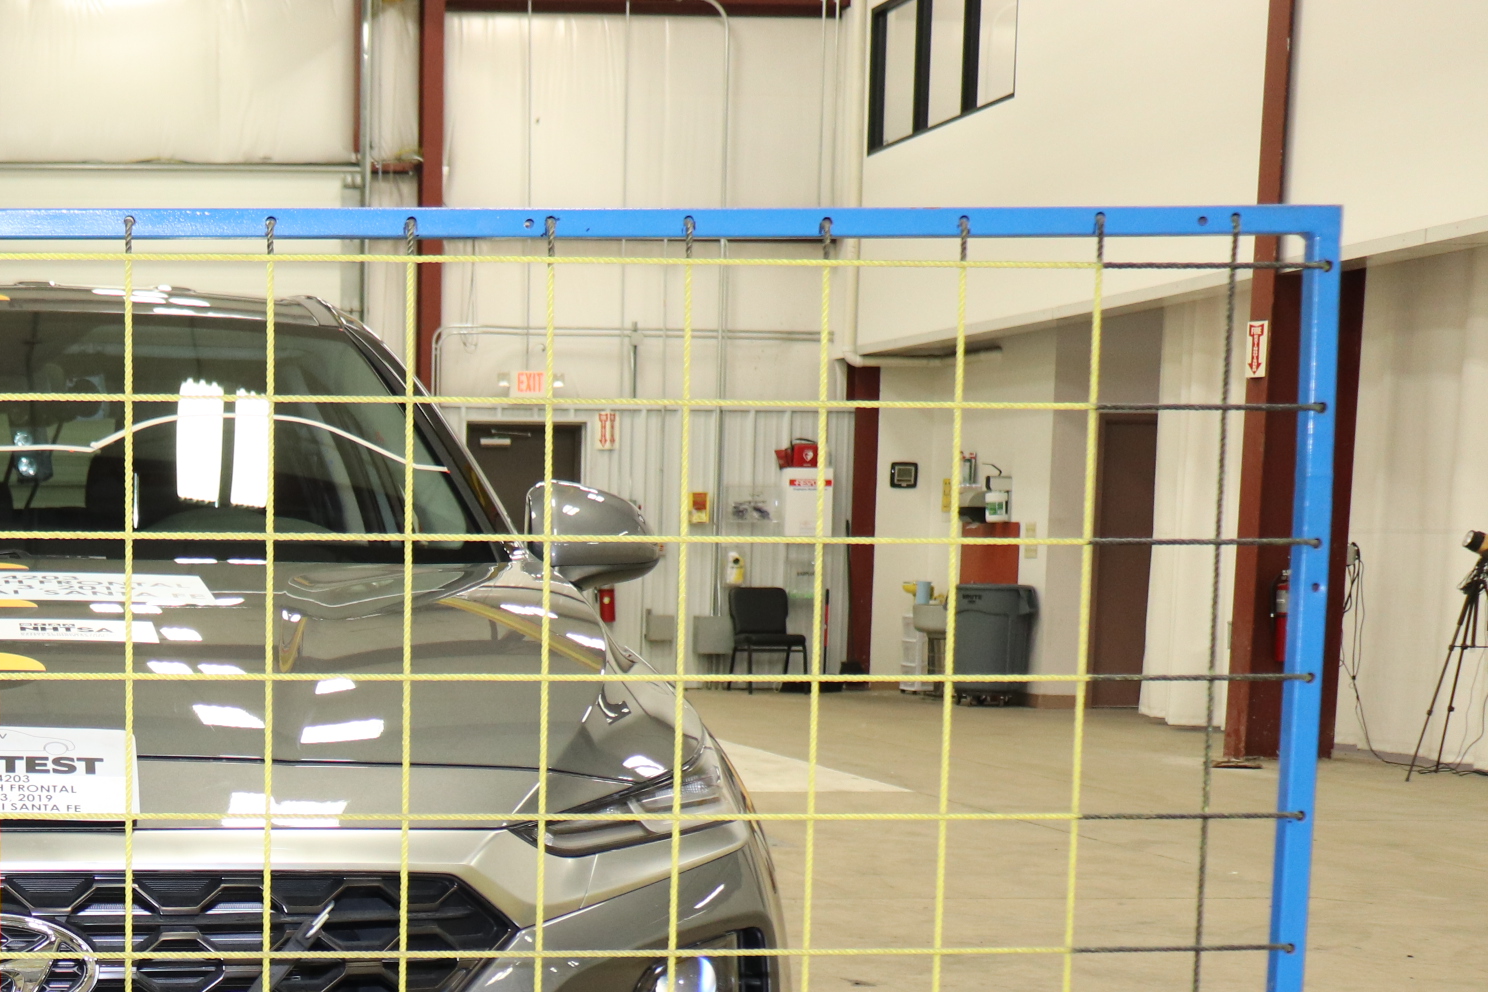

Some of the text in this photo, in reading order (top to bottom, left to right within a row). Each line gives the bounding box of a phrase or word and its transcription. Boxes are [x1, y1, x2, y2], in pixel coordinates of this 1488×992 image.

[517, 371, 545, 393] EXIT
[39, 580, 190, 588] FRONTAL
[44, 590, 158, 598] SANTA
[10, 784, 77, 794] FRONTAL
[18, 794, 53, 802] 2019
[11, 803, 60, 812] SANTA
[66, 805, 82, 813] FE
